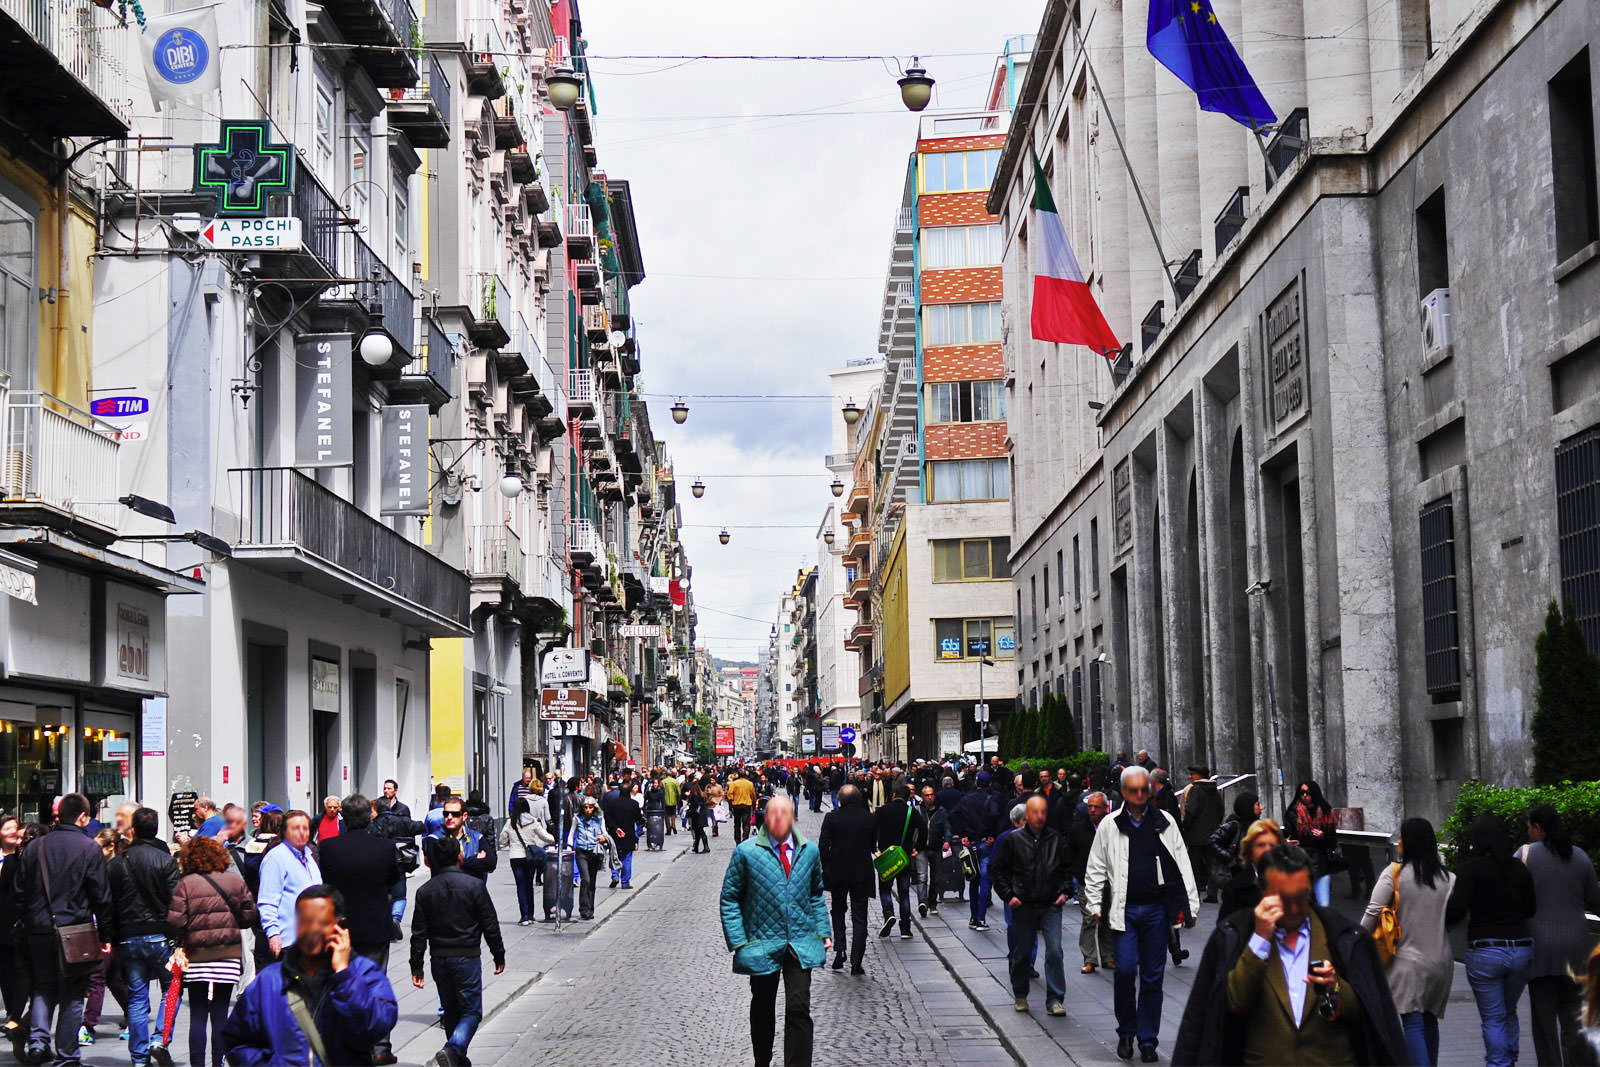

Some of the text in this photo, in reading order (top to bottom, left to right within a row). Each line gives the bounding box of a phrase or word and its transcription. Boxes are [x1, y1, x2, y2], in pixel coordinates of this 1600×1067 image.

[167, 45, 194, 66] DIBI
[220, 220, 292, 232] A POCHI
[231, 235, 280, 247] PASSI
[117, 399, 143, 413] TIM
[317, 342, 332, 461] STEFANEL
[399, 409, 412, 509] STEFANEL
[623, 626, 658, 636] PELLICCE
[940, 637, 960, 651] fabi
[544, 672, 557, 680] HOTEL
[562, 669, 583, 678] CONVENTO
